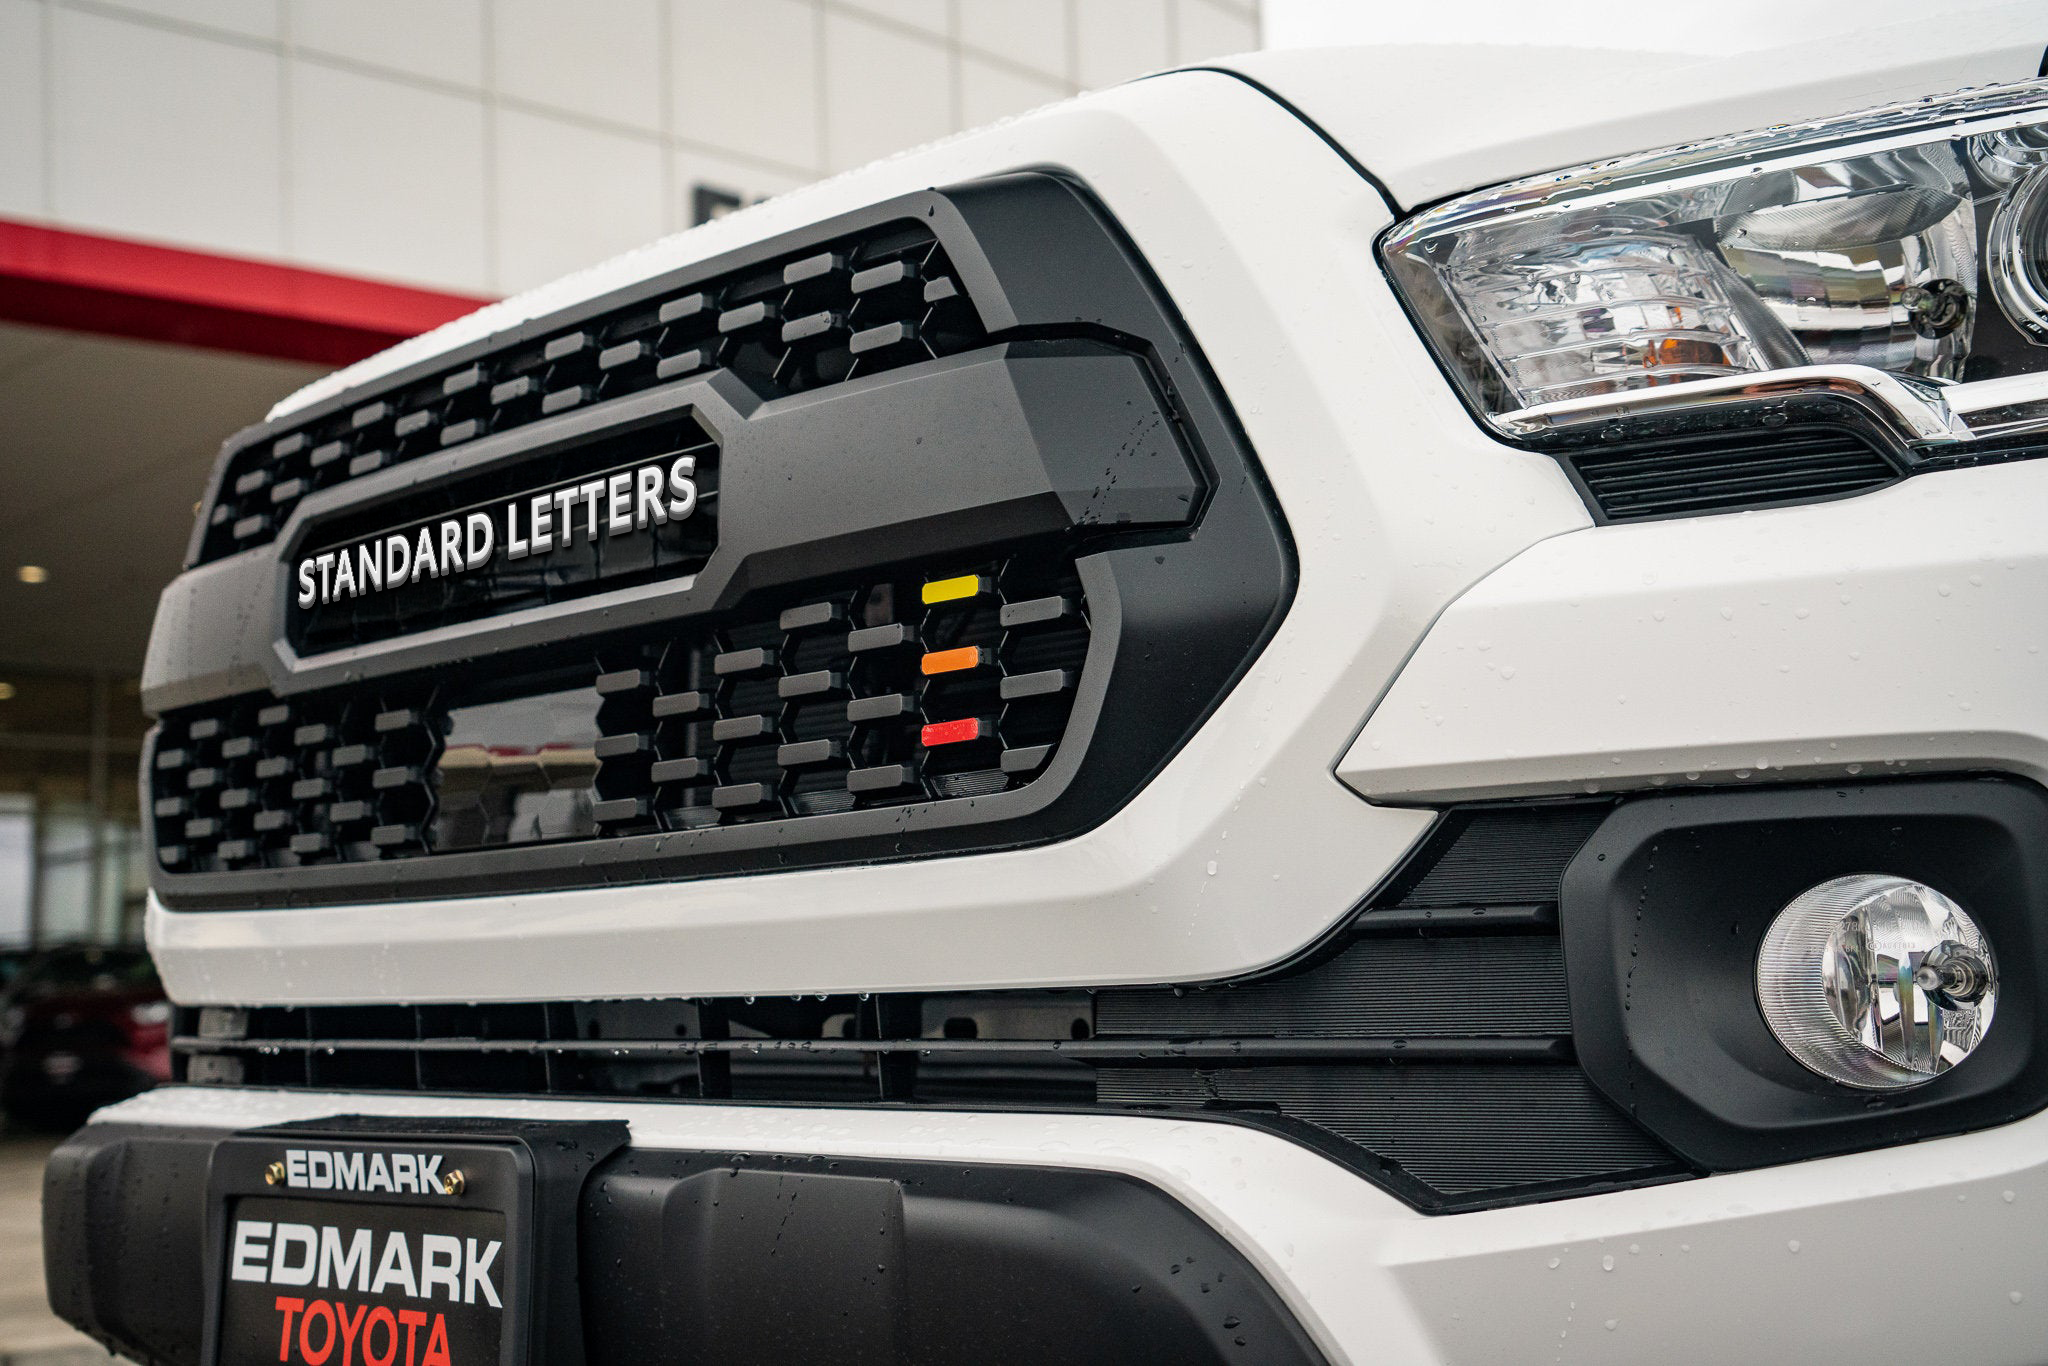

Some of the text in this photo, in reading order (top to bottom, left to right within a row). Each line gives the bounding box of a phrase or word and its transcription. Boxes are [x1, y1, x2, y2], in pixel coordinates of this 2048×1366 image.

[299, 455, 697, 609] STANDARD LETTERS
[286, 1150, 447, 1195] EDMARK
[232, 1220, 503, 1309] EDMARK
[275, 1296, 452, 1366] TOYOTA
